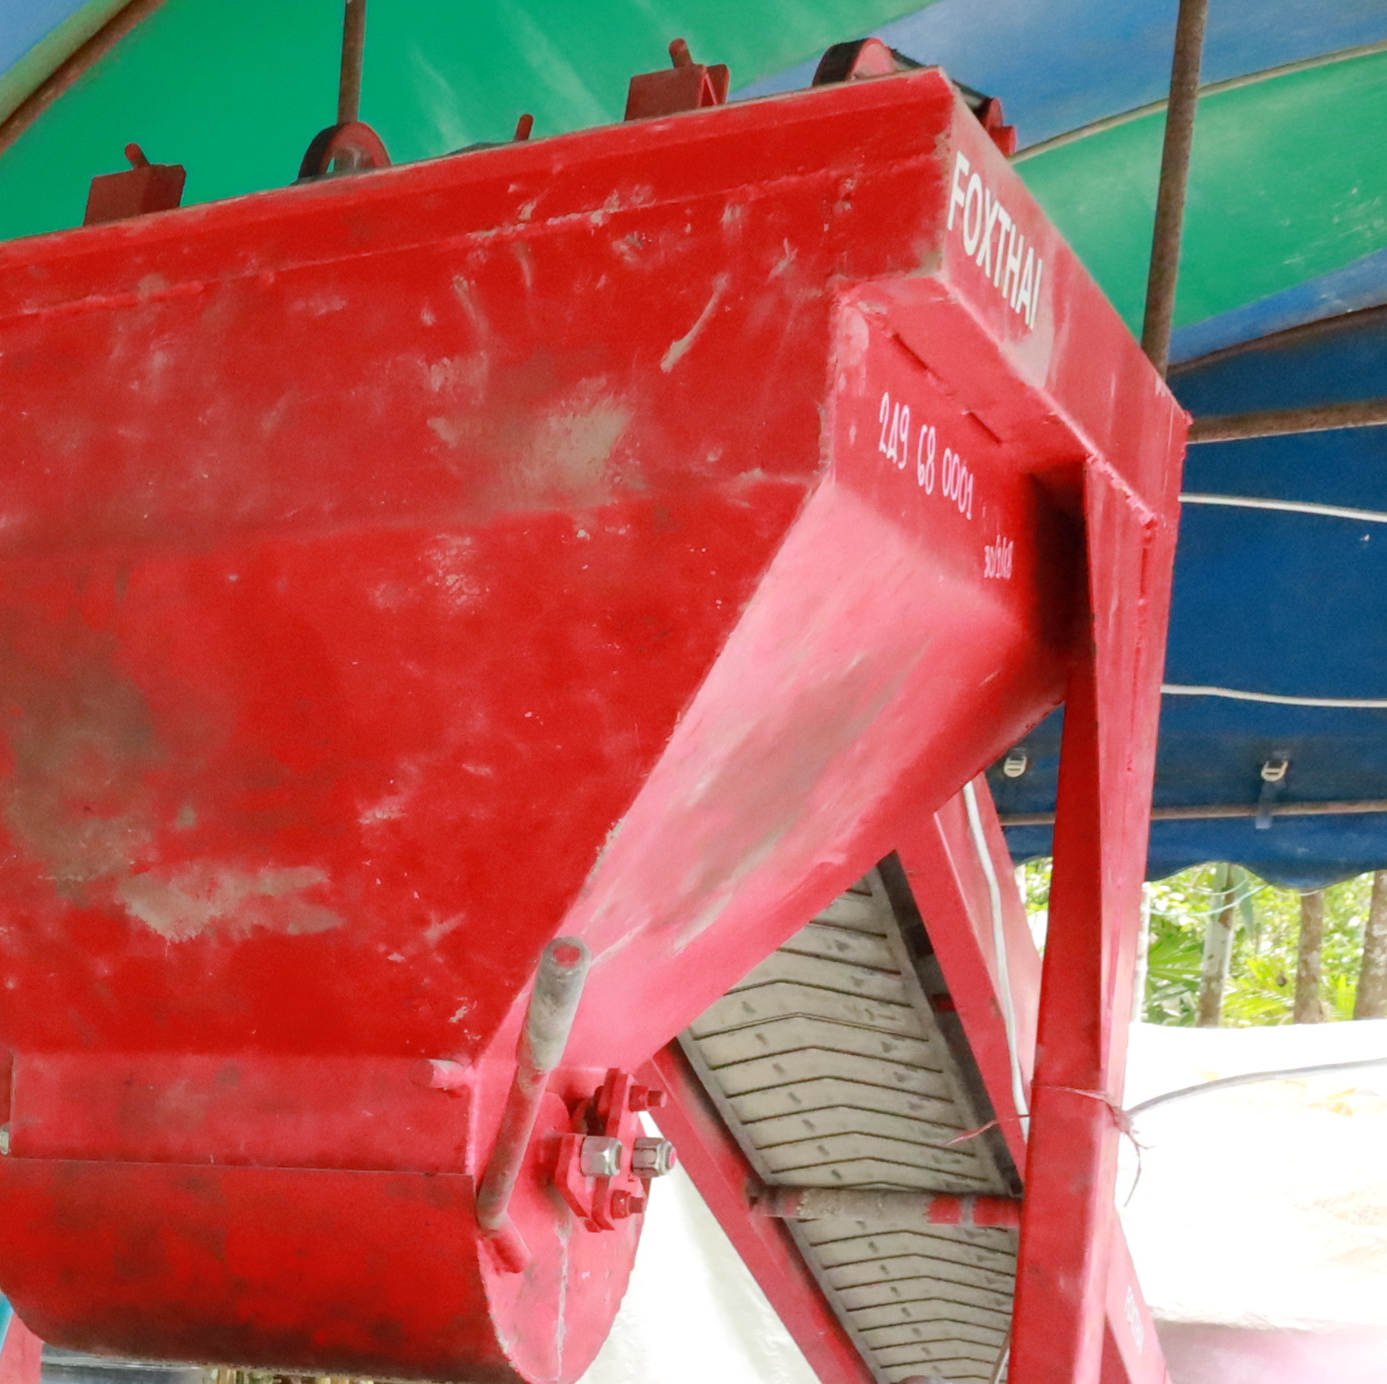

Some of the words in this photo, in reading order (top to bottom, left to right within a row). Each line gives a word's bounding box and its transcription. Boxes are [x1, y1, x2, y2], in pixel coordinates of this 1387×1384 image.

[948, 151, 1044, 330] FOXTHAI
[917, 424, 936, 495] 68
[942, 447, 974, 520] 0001
